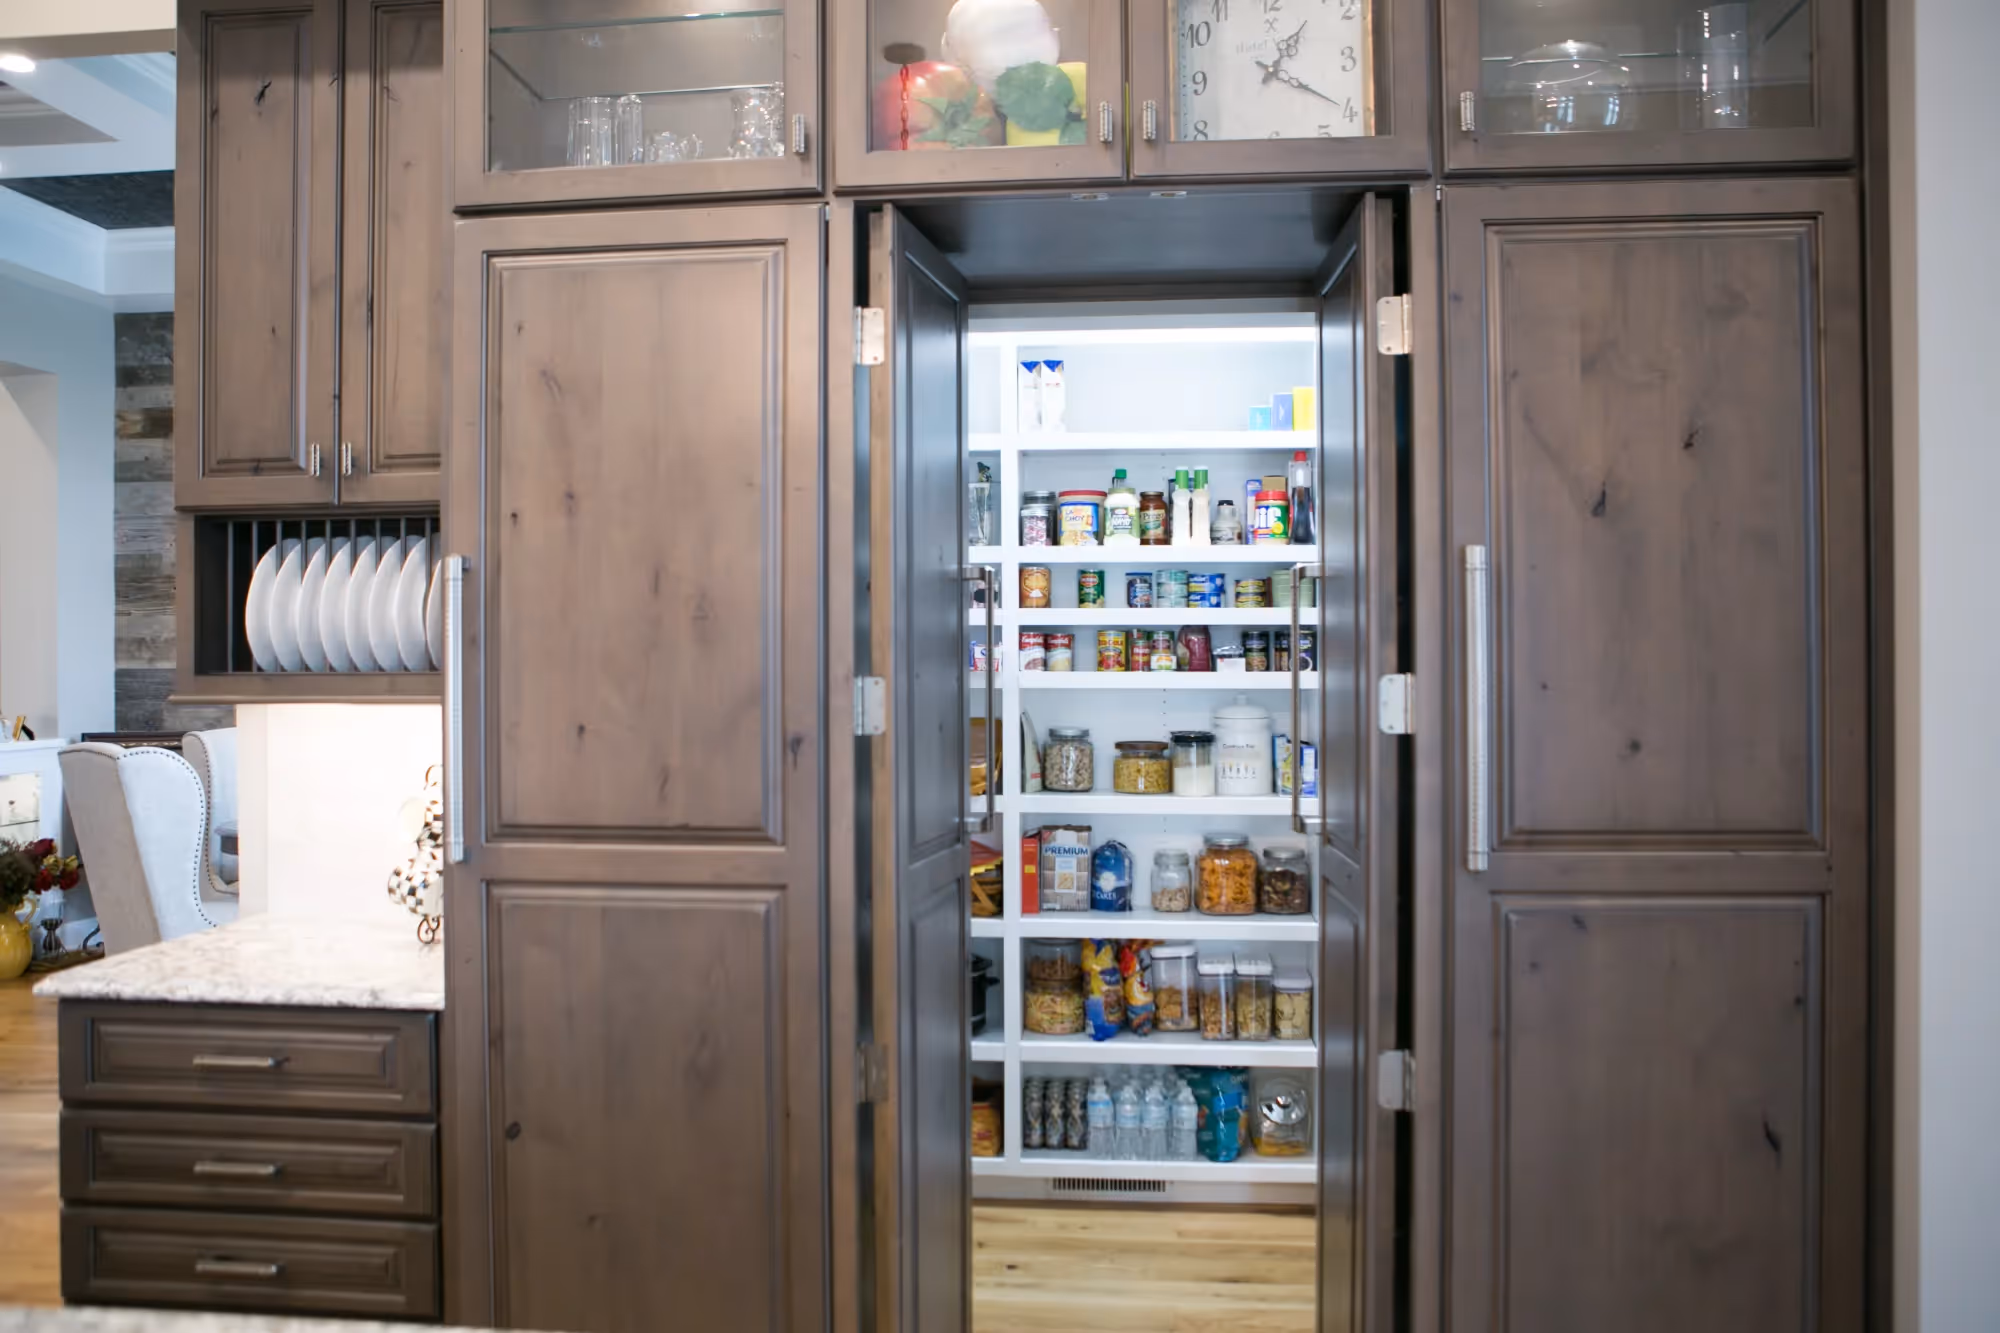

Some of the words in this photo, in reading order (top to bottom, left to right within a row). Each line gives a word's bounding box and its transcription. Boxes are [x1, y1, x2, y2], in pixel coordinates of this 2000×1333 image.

[1340, 0, 1356, 21] 2
[1186, 21, 1211, 48] 10
[1340, 46, 1356, 72] 3
[1191, 71, 1207, 96] 9
[1342, 97, 1358, 123] 4
[1193, 120, 1209, 141] 8
[1045, 847, 1089, 856] PREMIUM
